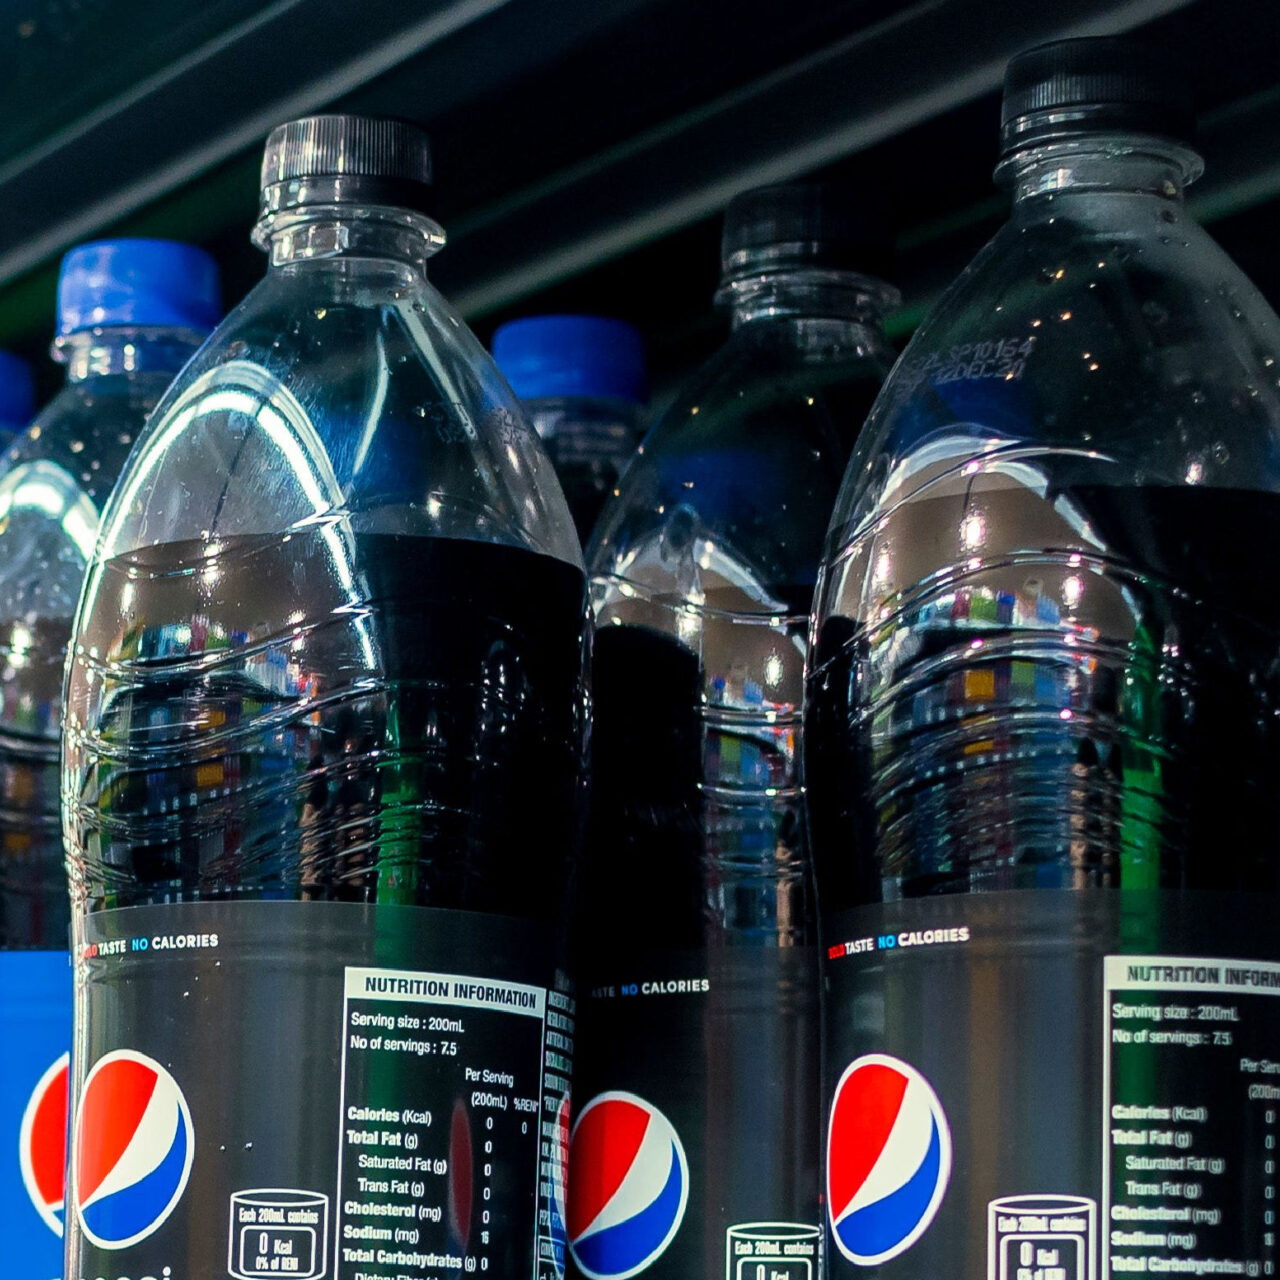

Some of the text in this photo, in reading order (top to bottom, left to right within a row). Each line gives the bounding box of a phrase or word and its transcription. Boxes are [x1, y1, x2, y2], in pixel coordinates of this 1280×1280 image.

[99, 940, 126, 956] TASTE
[132, 938, 149, 951] NO
[152, 934, 219, 951] CALORIES
[845, 938, 874, 955] TASTE
[878, 935, 895, 949] NO
[898, 927, 970, 947] CALORIES
[1127, 966, 1219, 984] NUTRITION
[365, 977, 536, 1009] NUTRITION INFORMATION
[592, 979, 710, 998] ASTE NO CALORIES
[351, 1012, 394, 1029] Serving
[397, 1014, 420, 1029] size
[428, 1017, 465, 1033] 200mL
[350, 1035, 367, 1049] No
[370, 1036, 382, 1050] of
[384, 1039, 430, 1055] servings
[441, 1041, 457, 1056] 7.5
[465, 1067, 514, 1088] Per Serving
[471, 1092, 508, 1111] (200mL)
[347, 1106, 528, 1134] Calories (Kcal) 0 0
[347, 1130, 492, 1153] Total Fat (g) 0
[358, 1154, 491, 1177] Saturated Fat (g) 0
[358, 1178, 491, 1200] Trans Fat (g) 0
[239, 1208, 256, 1222] Each
[288, 1209, 318, 1224] contains
[344, 1201, 490, 1224] Cholesterol (mg) 0
[259, 1232, 292, 1254] 0 Kcal
[343, 1225, 392, 1241] Sodium
[394, 1227, 419, 1243] (mg)
[256, 1257, 268, 1270] 0%
[271, 1257, 279, 1270] of
[342, 1248, 488, 1272] Total Carbohydrates (g) 0
